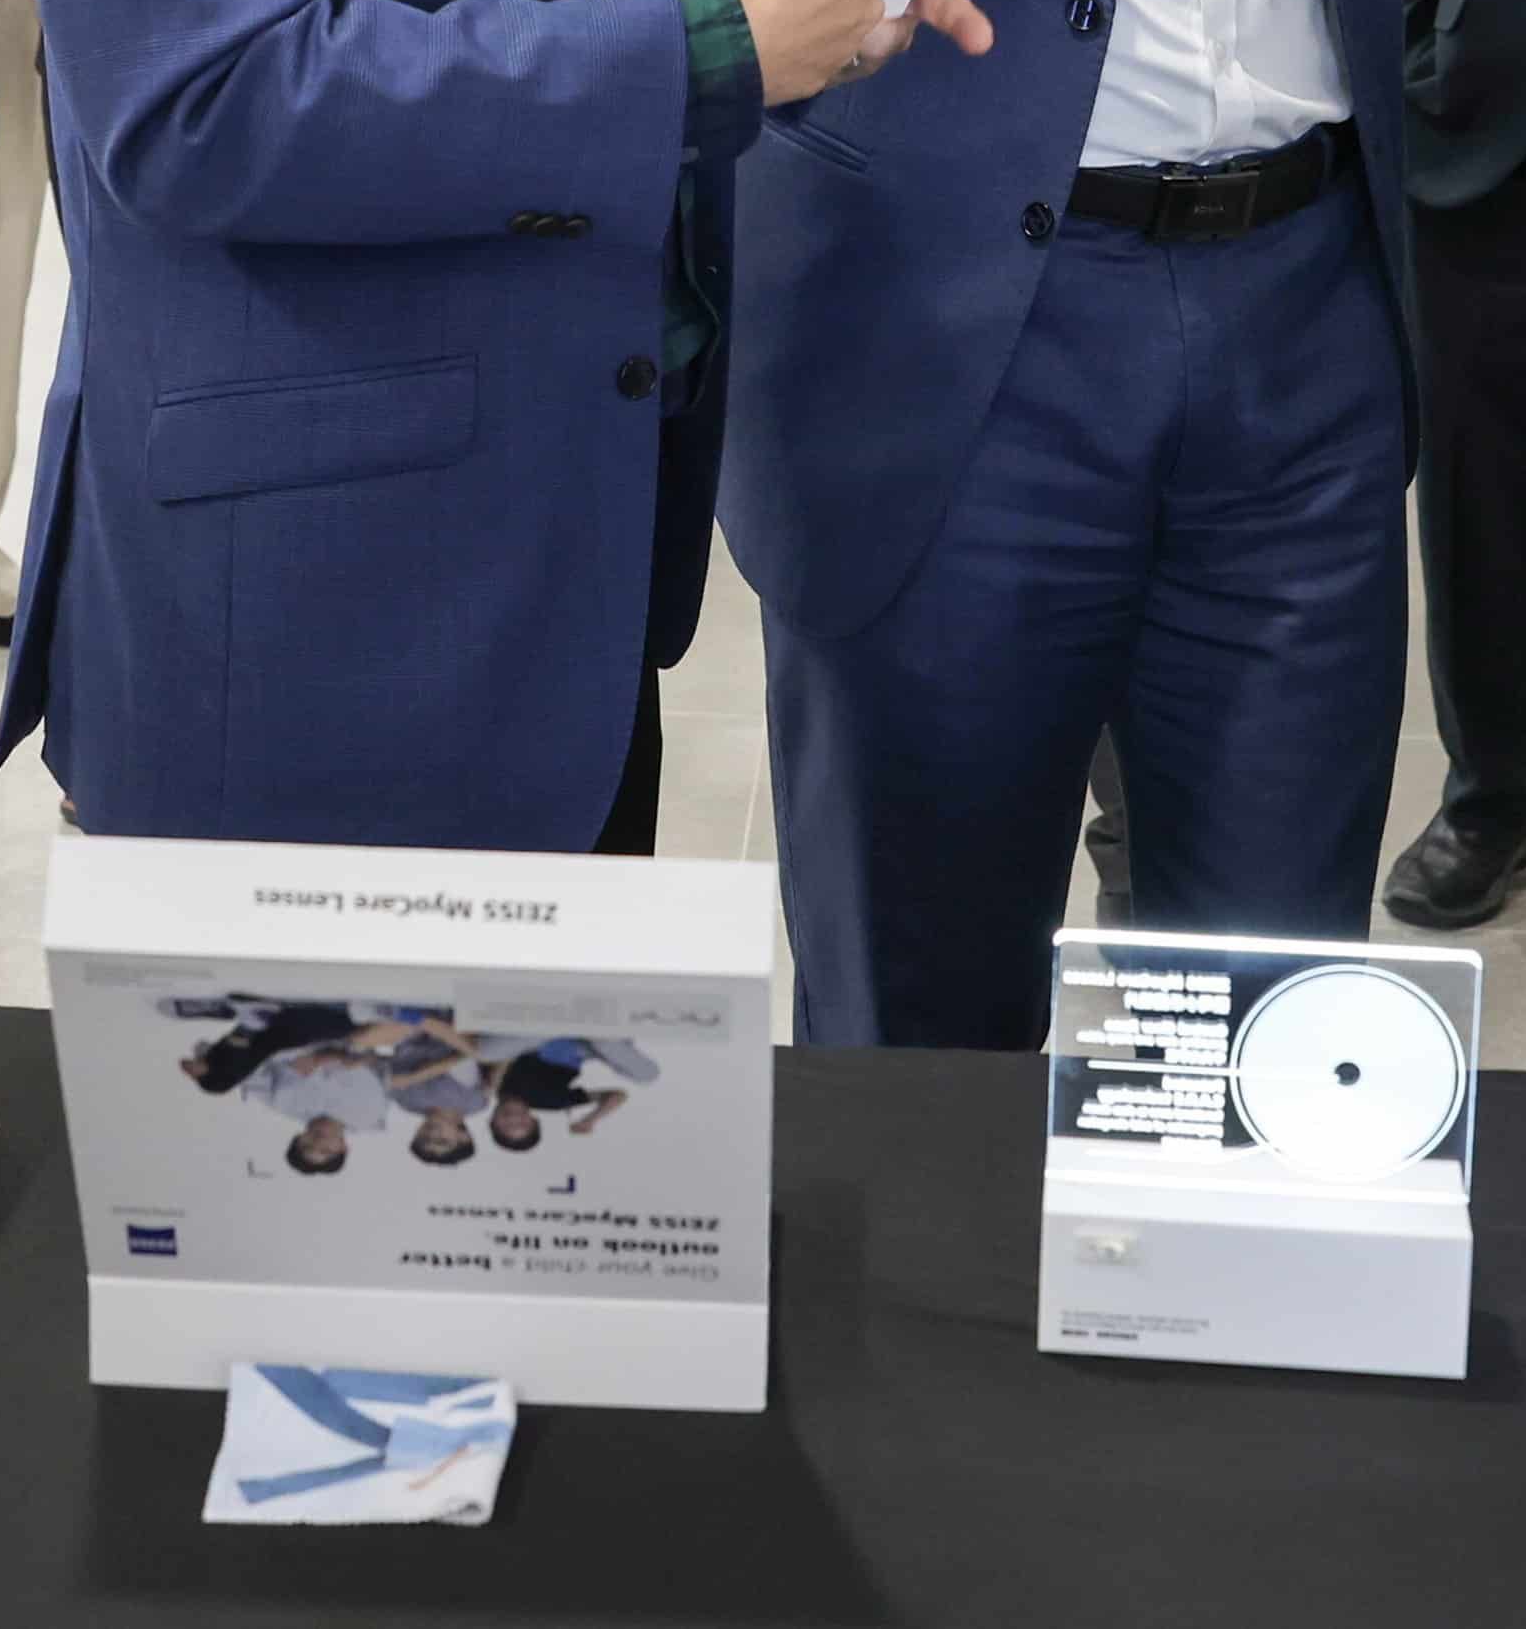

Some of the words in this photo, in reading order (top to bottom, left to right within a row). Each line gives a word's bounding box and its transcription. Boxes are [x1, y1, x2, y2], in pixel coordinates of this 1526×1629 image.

[253, 888, 344, 913] Lenses
[353, 891, 473, 919] MyoCare
[482, 900, 558, 923] ZEISS
[428, 1204, 515, 1221] Lenses
[526, 1208, 638, 1228] MyoCare
[649, 1215, 720, 1231] ZEISS
[552, 1235, 589, 1249] on
[604, 1238, 720, 1256] outlook
[400, 1253, 492, 1271] better
